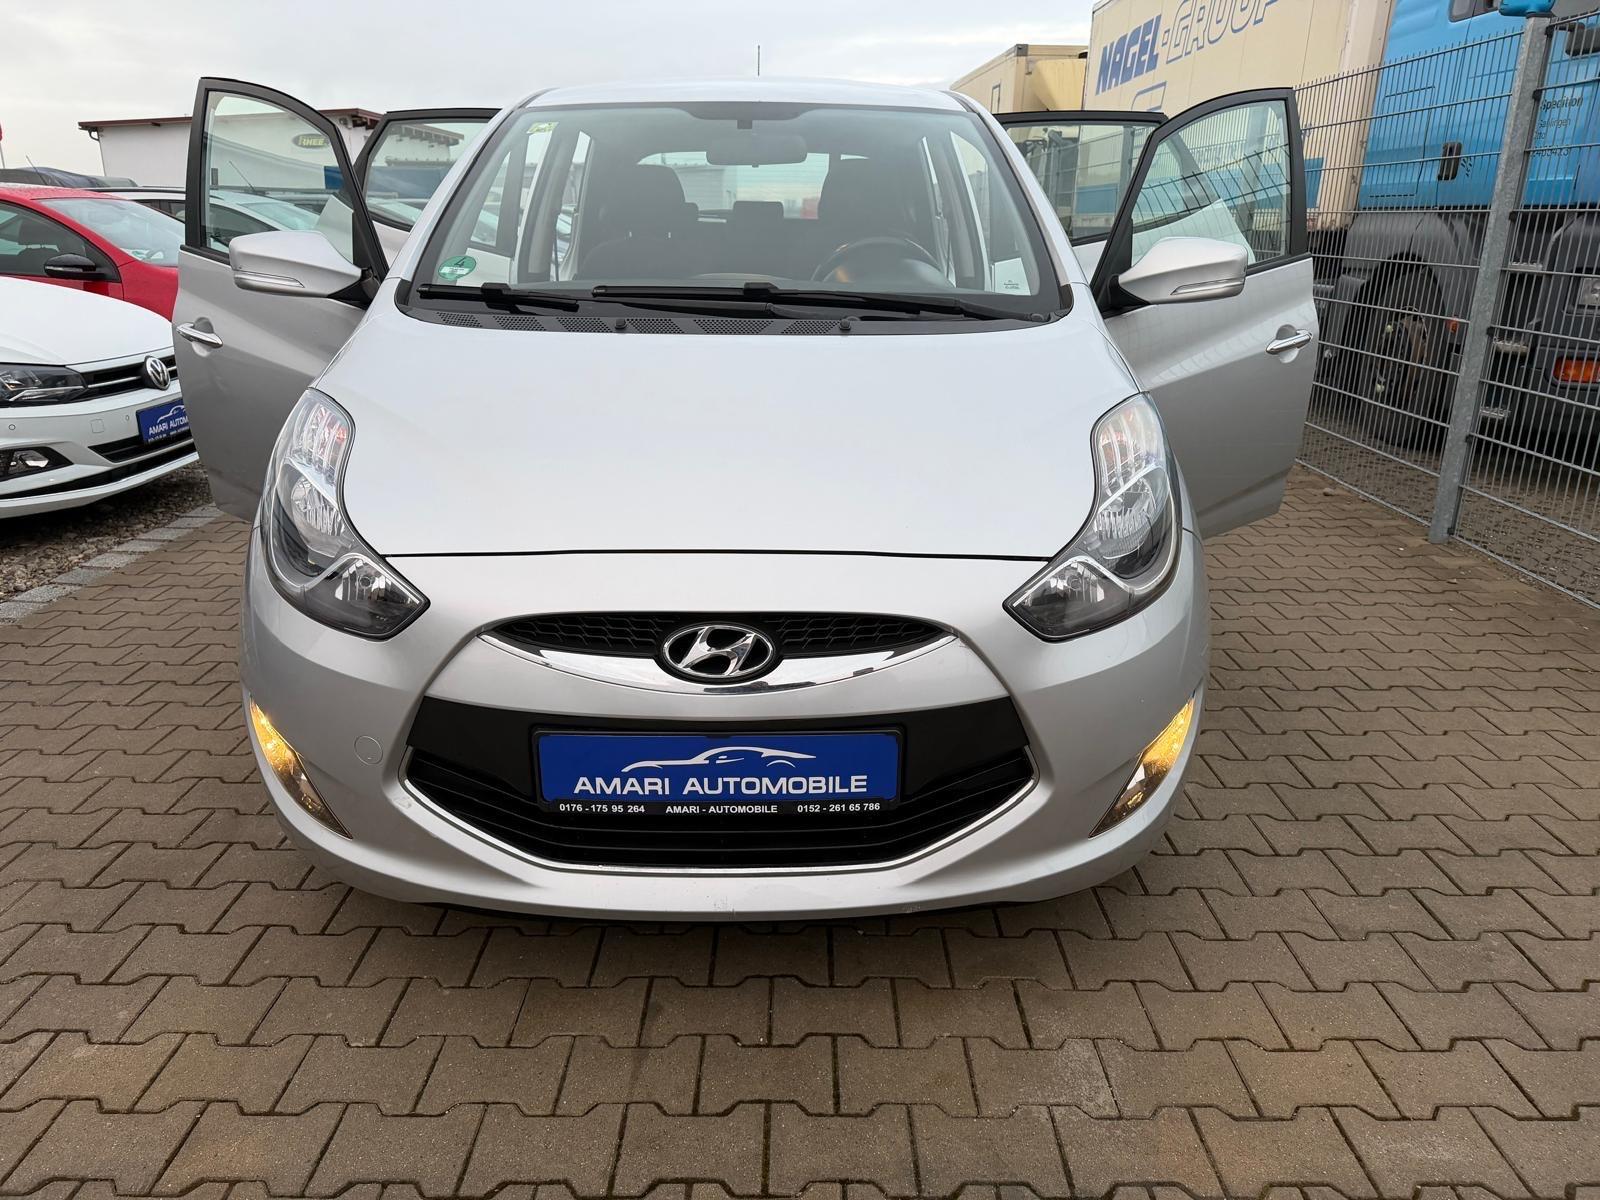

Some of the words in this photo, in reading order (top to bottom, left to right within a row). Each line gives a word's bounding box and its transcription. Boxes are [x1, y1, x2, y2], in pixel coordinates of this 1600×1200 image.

[454, 256, 466, 268] 4
[148, 422, 169, 436] AMARI
[573, 776, 670, 795] AMARI
[682, 775, 868, 795] AUTOMOBILE
[559, 803, 583, 812] 0176
[590, 804, 609, 813] 175
[611, 804, 624, 813] 95
[627, 804, 646, 813] 264
[665, 805, 700, 814] AMARI
[708, 805, 778, 814] AUTOMOBILE
[797, 804, 821, 813] 0152
[829, 803, 846, 812] 261
[848, 803, 861, 812] 65
[863, 802, 881, 811] 786
